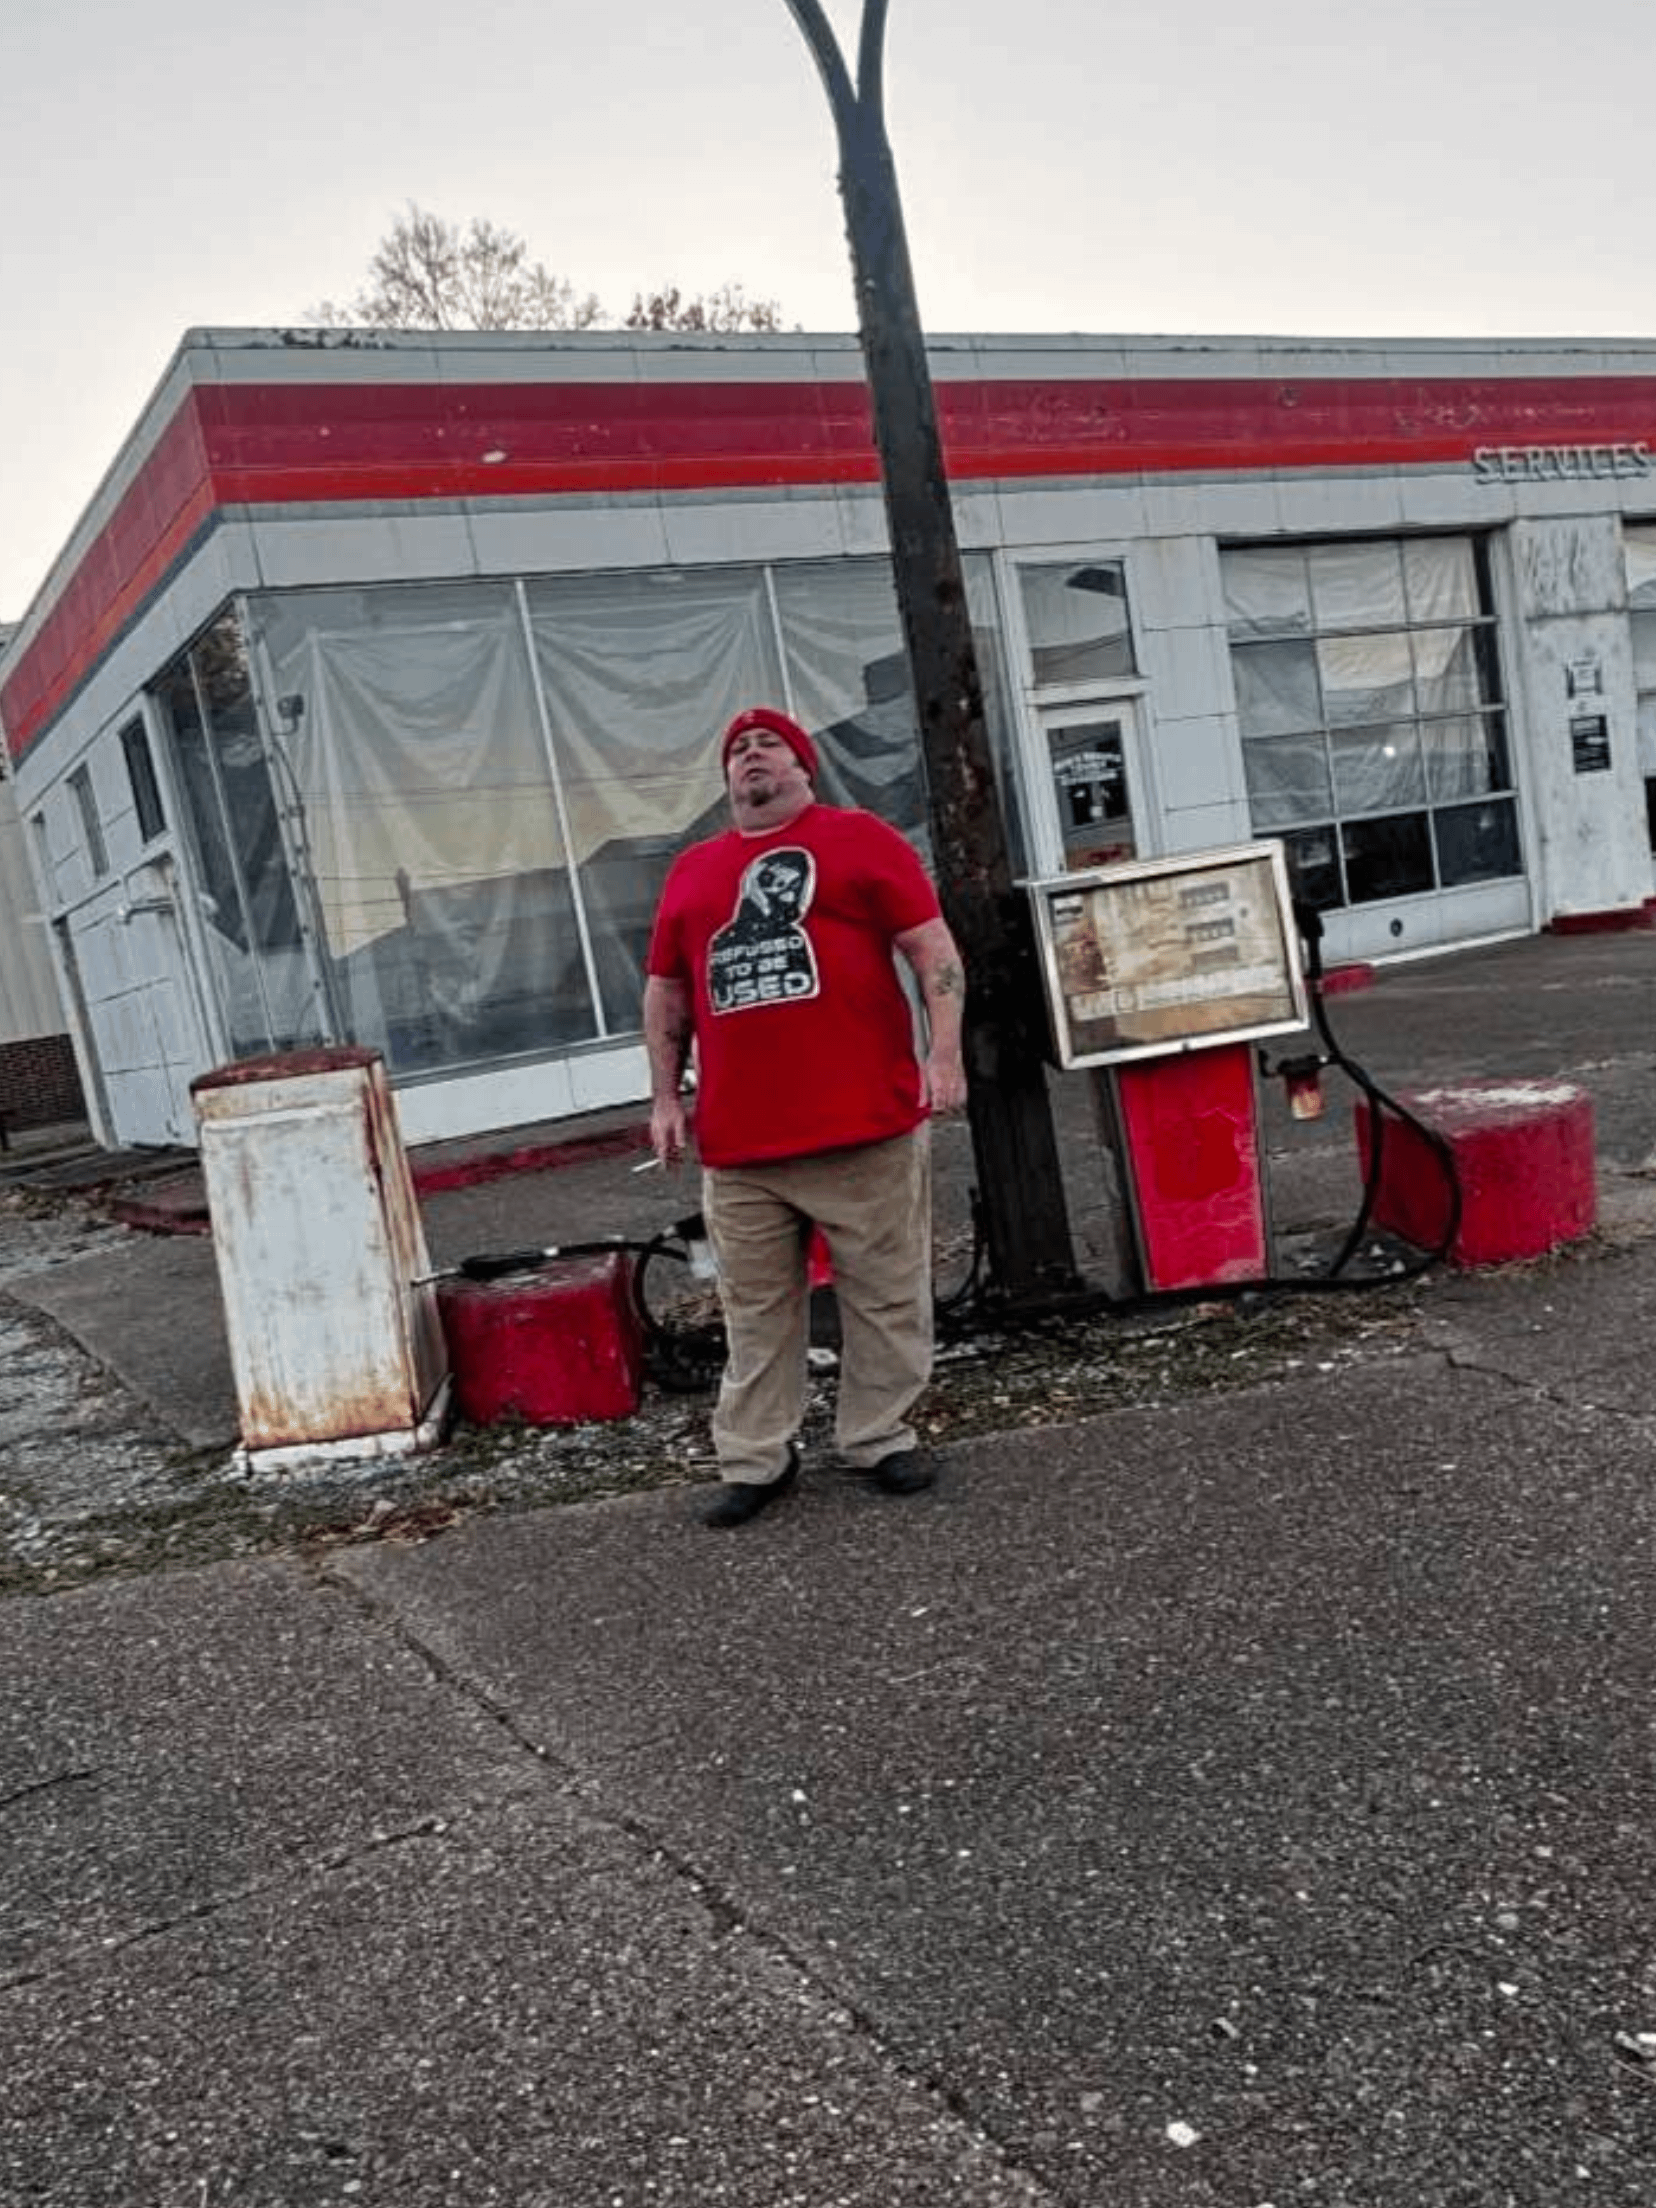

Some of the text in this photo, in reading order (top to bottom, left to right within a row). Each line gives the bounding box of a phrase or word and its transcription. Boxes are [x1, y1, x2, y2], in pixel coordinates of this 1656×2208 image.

[1473, 442, 1649, 483] SERVICES
[714, 971, 811, 1008] USED
[725, 962, 751, 980] TO
